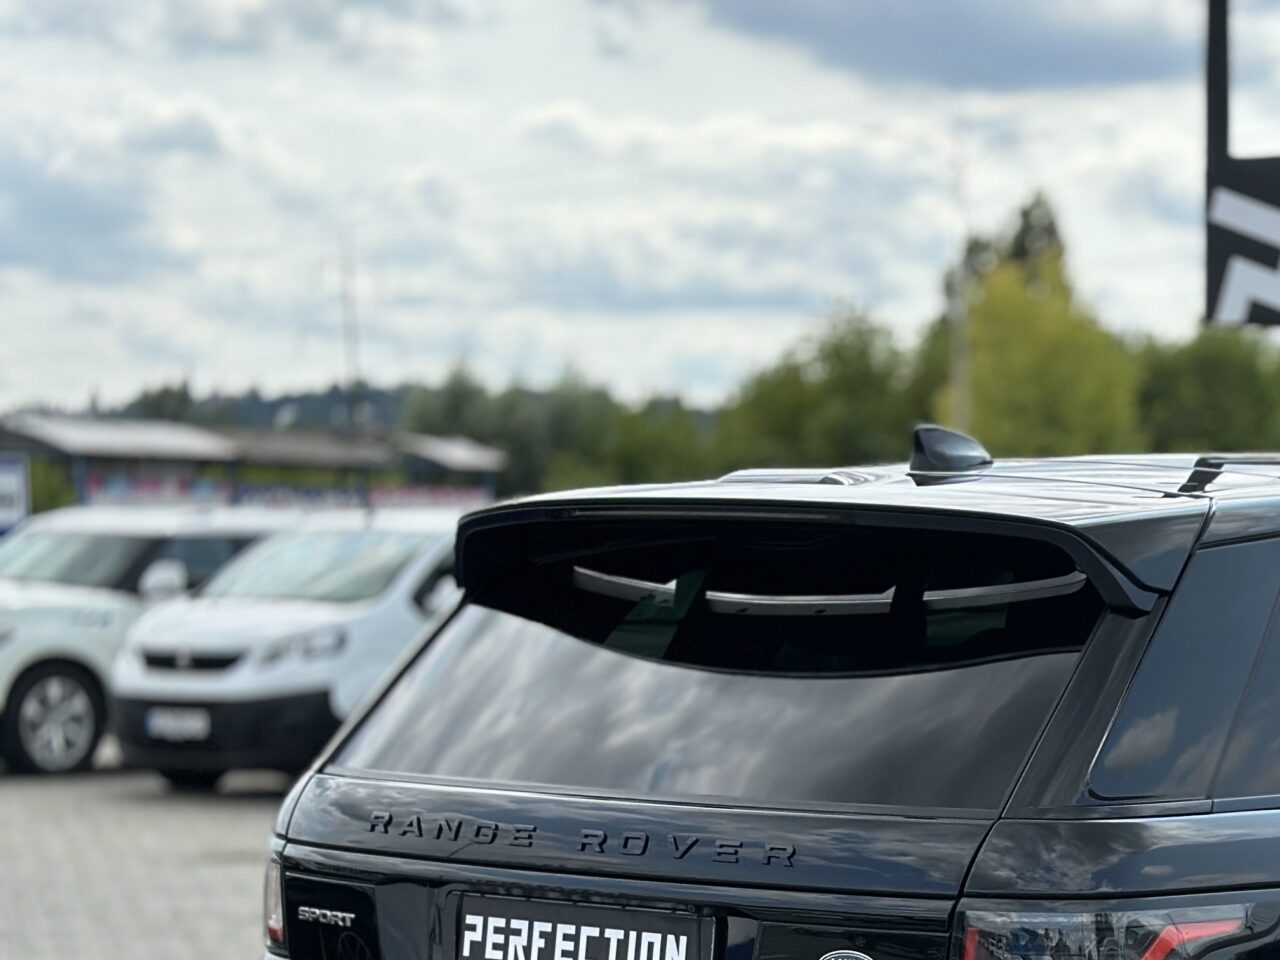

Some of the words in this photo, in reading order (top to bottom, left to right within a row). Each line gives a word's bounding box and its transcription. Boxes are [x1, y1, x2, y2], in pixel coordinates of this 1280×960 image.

[368, 809, 538, 849] RANGE
[576, 828, 797, 868] ROVER
[298, 906, 355, 927] SPORT
